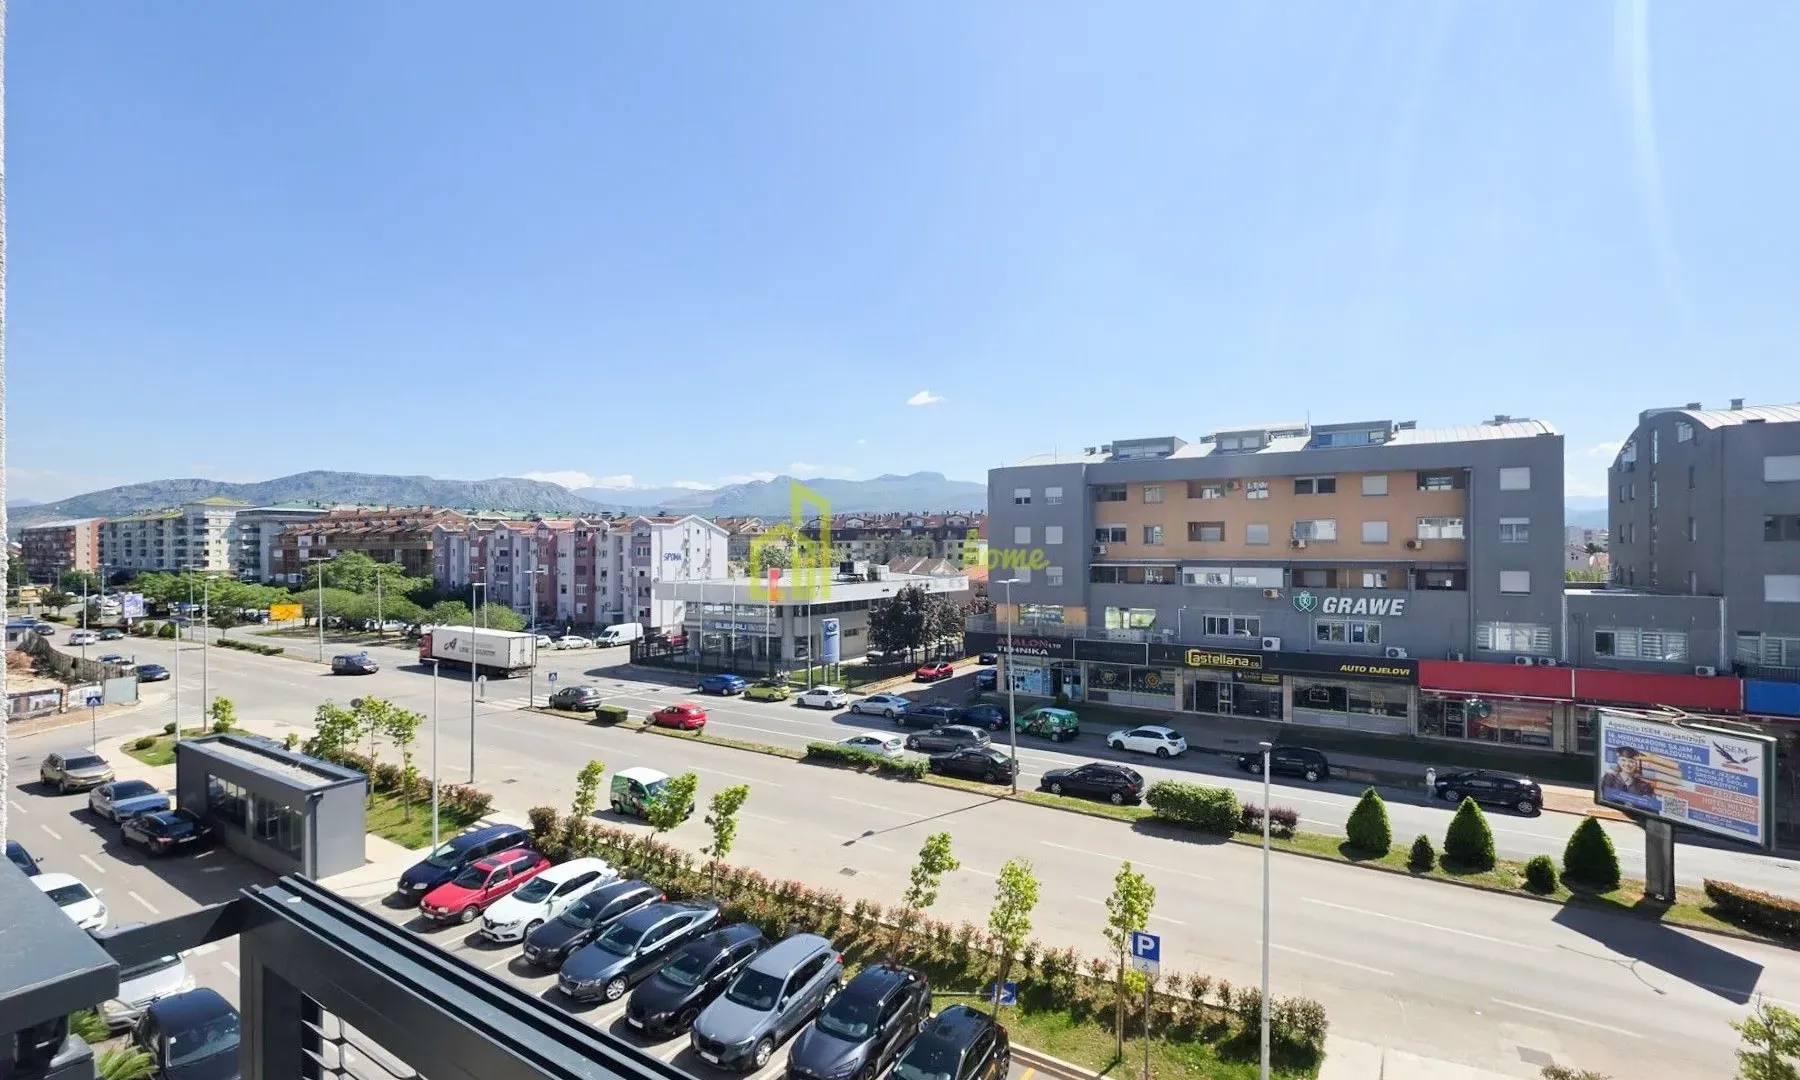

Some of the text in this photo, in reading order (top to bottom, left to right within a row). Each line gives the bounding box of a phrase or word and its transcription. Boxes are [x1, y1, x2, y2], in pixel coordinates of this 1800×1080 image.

[1322, 597, 1405, 616] GRAWE
[997, 645, 1048, 655] TEHNIKA
[1188, 649, 1249, 666] Castellana
[1340, 664, 1410, 675] AUTO DJELOVI
[1642, 726, 1660, 735] ISEM
[1137, 934, 1155, 956] P
